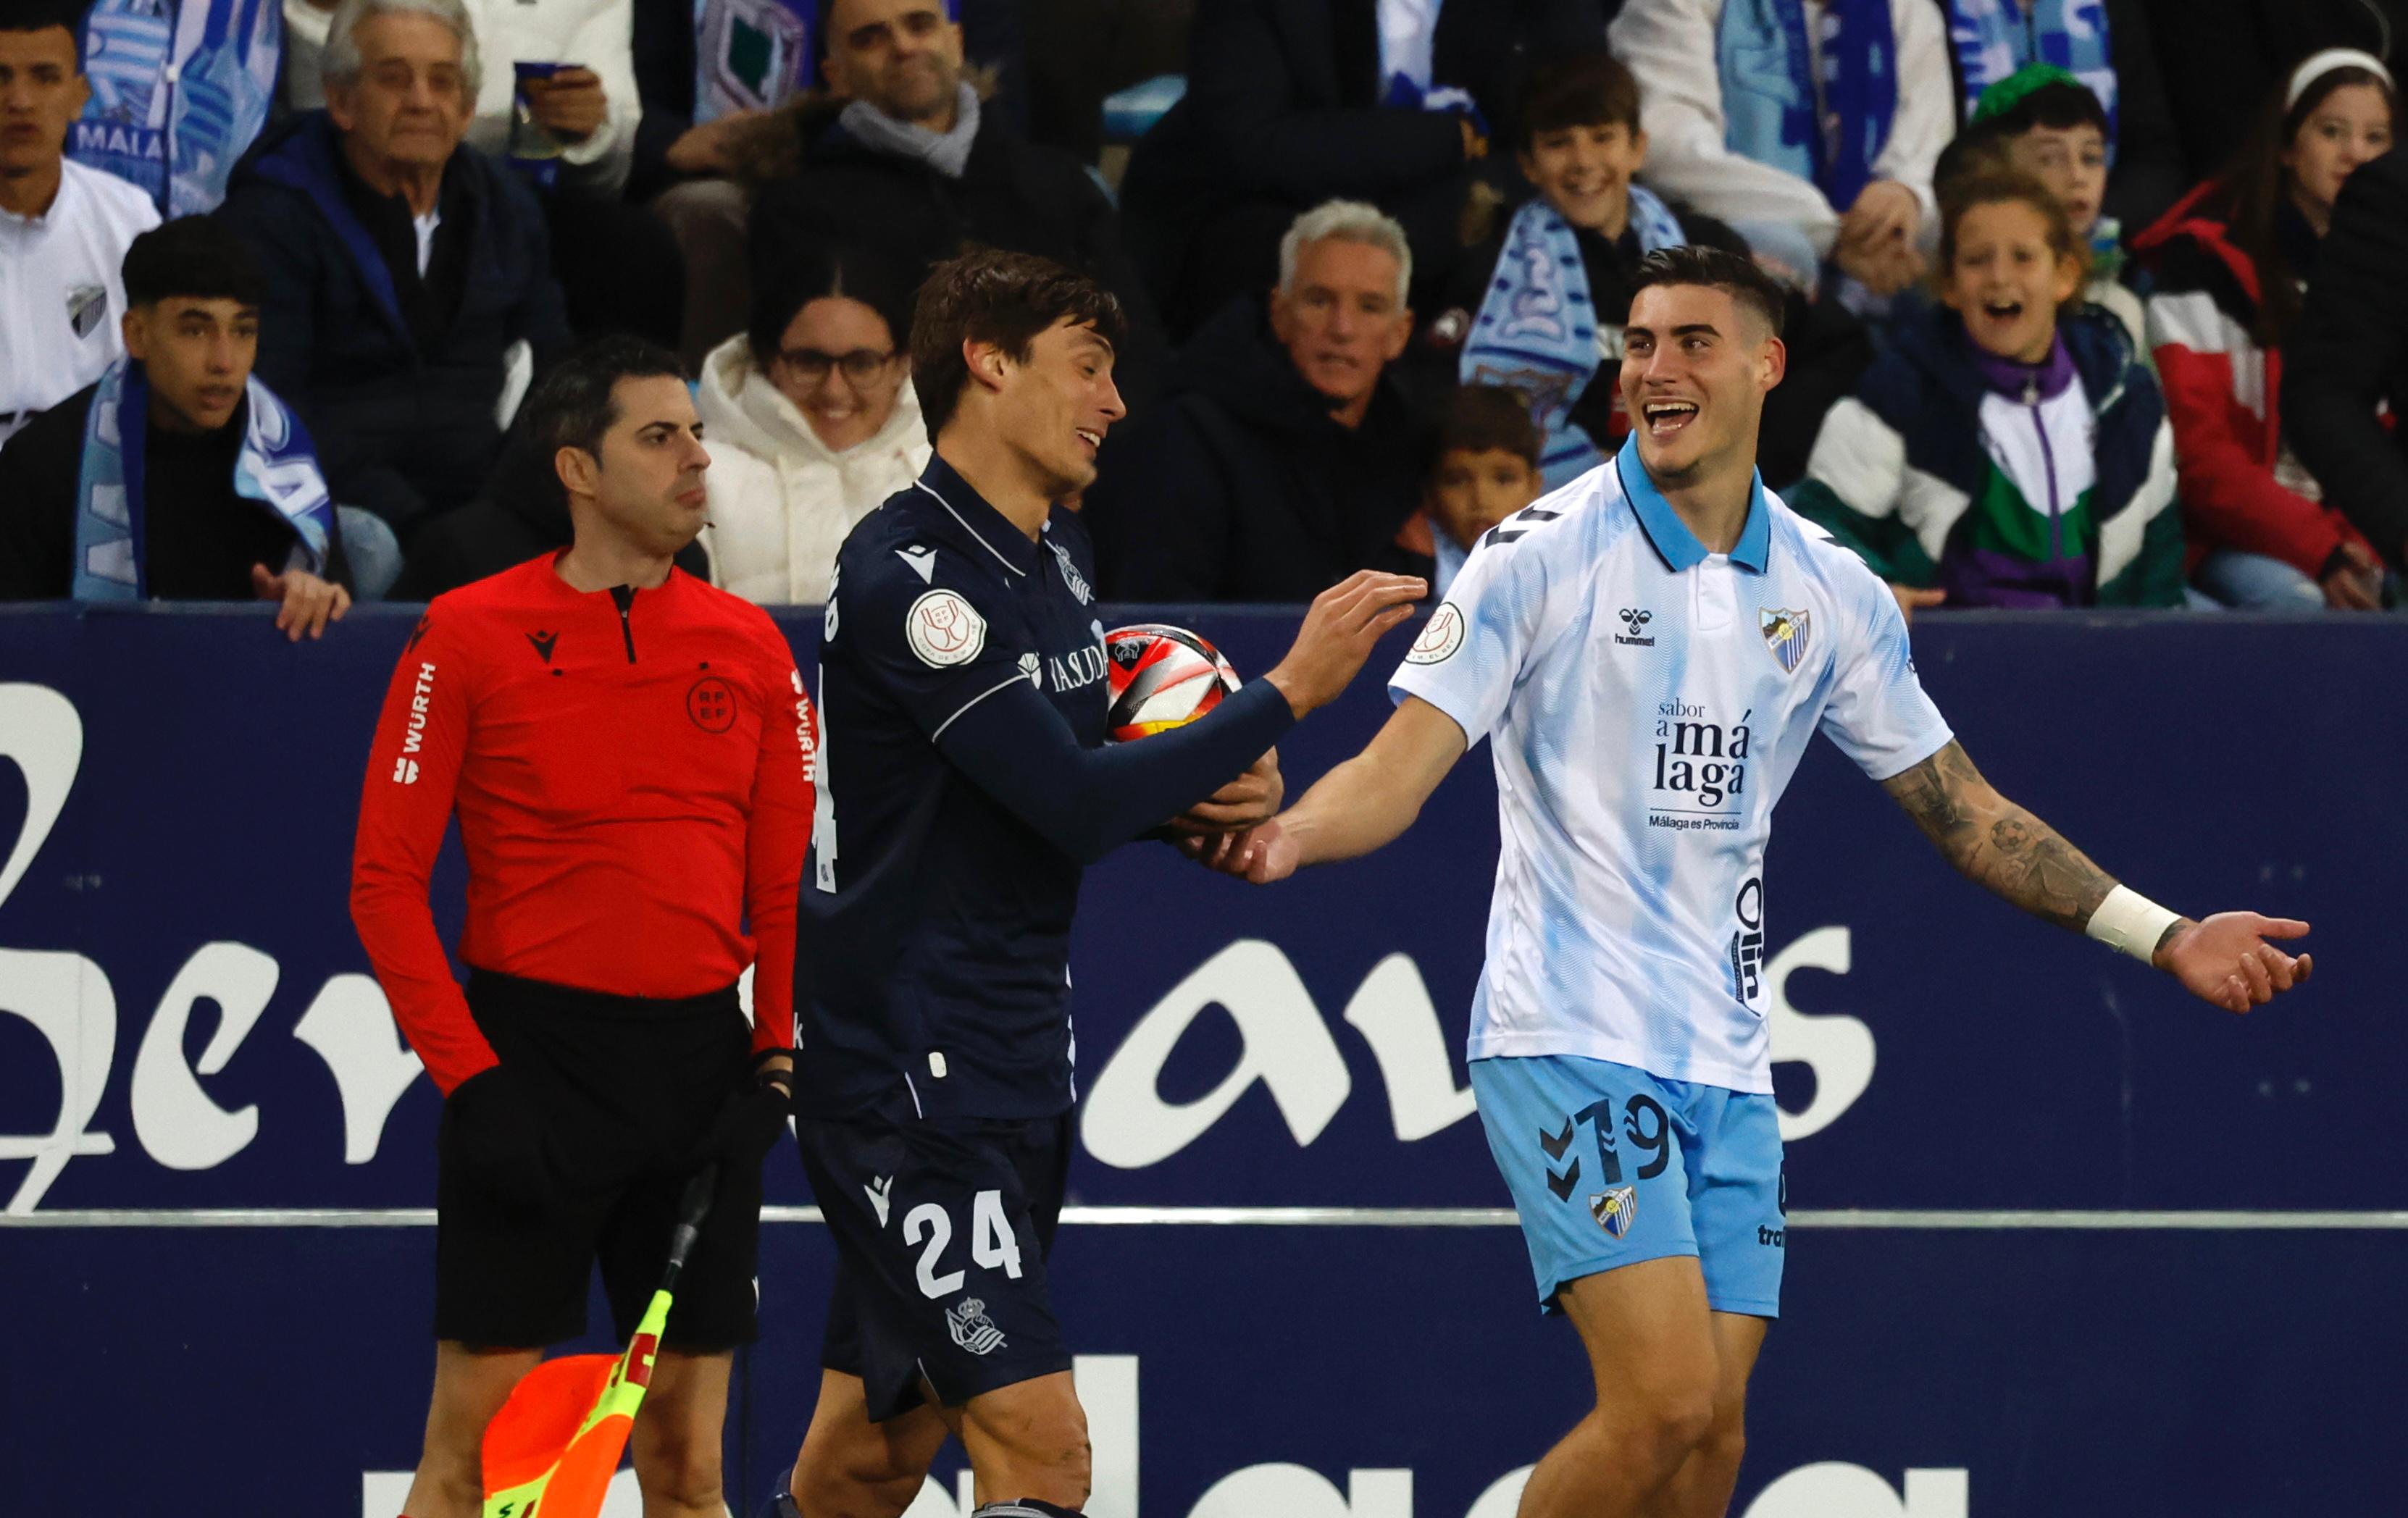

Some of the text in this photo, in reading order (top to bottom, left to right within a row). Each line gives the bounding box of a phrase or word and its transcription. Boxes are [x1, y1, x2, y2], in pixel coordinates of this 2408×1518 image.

[1615, 633, 1655, 647] hummel
[403, 663, 436, 752] WÜRTH
[1656, 708, 1752, 760] a má
[1657, 697, 1705, 718] sabor
[1653, 743, 1744, 807] laga
[1649, 815, 1739, 831] Málaga es Provincia
[1574, 1094, 1670, 1186] 19
[903, 1189, 1023, 1299] 24
